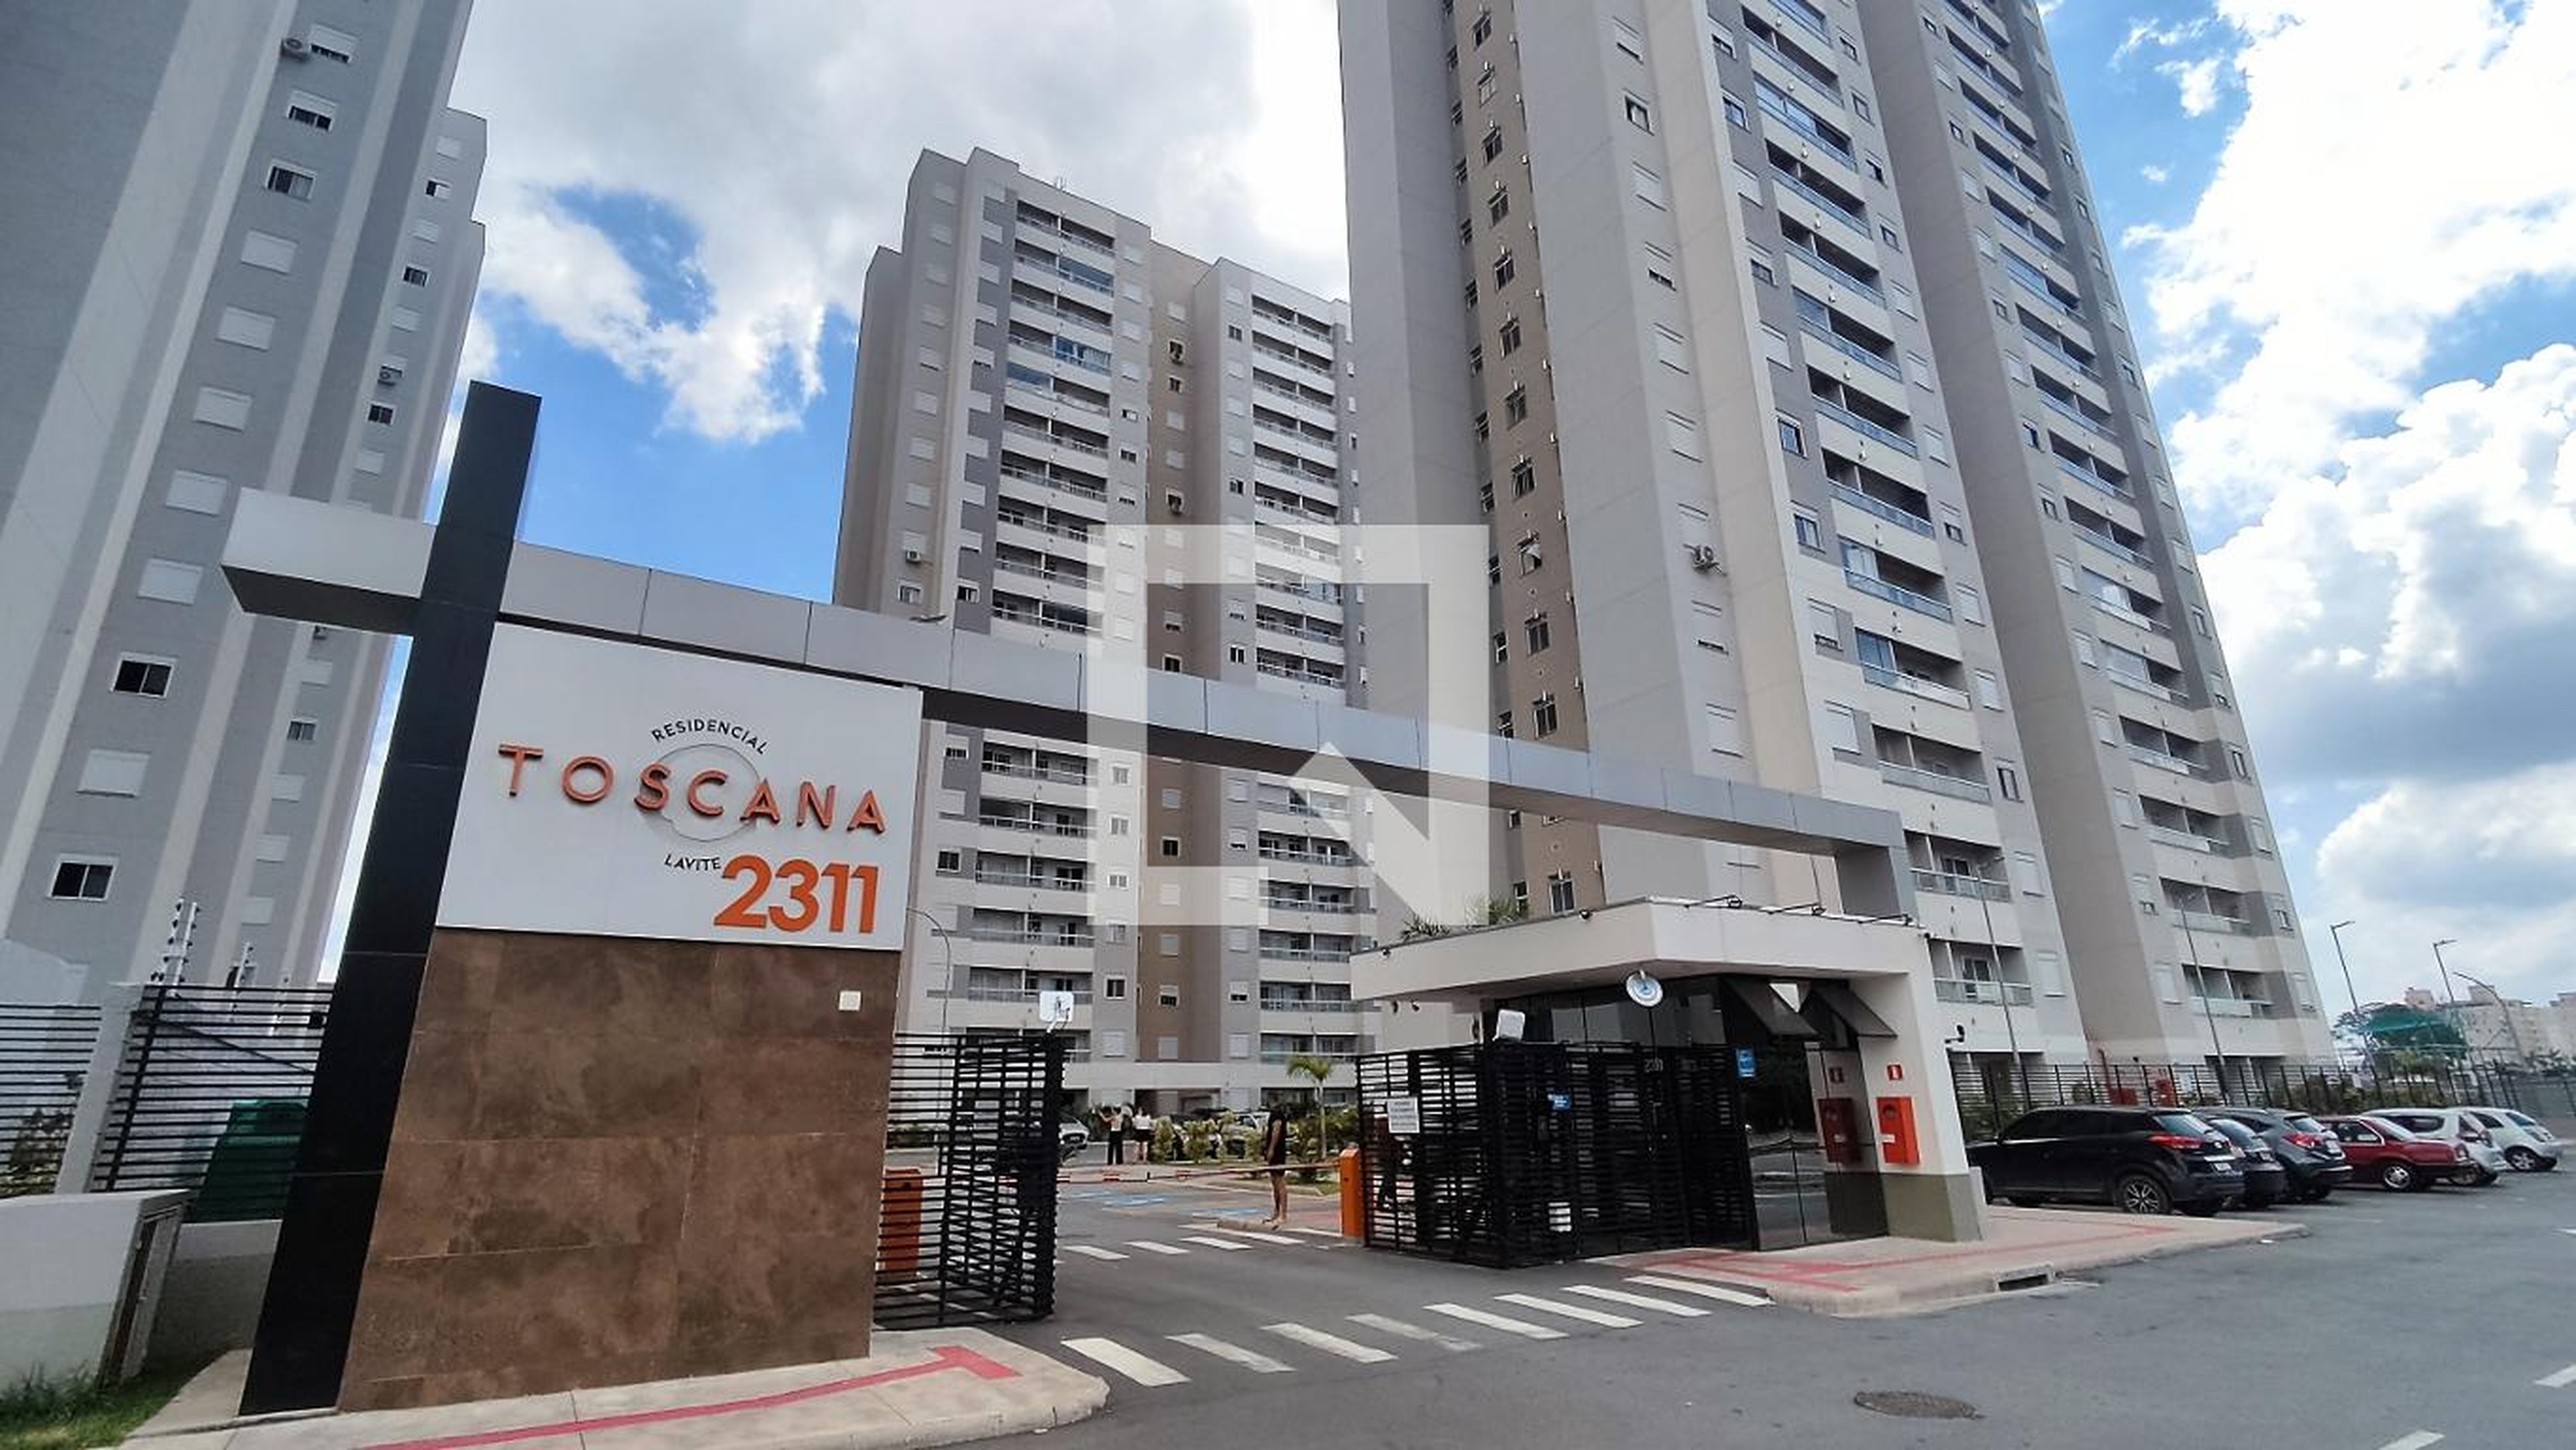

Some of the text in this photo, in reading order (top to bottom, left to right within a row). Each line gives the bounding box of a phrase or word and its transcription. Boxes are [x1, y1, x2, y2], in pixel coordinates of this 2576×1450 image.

[651, 719, 767, 755] RESIDENCIAL
[498, 743, 886, 834] TOSCANA
[664, 853, 722, 871] LAVITE
[714, 855, 878, 933] 2311
